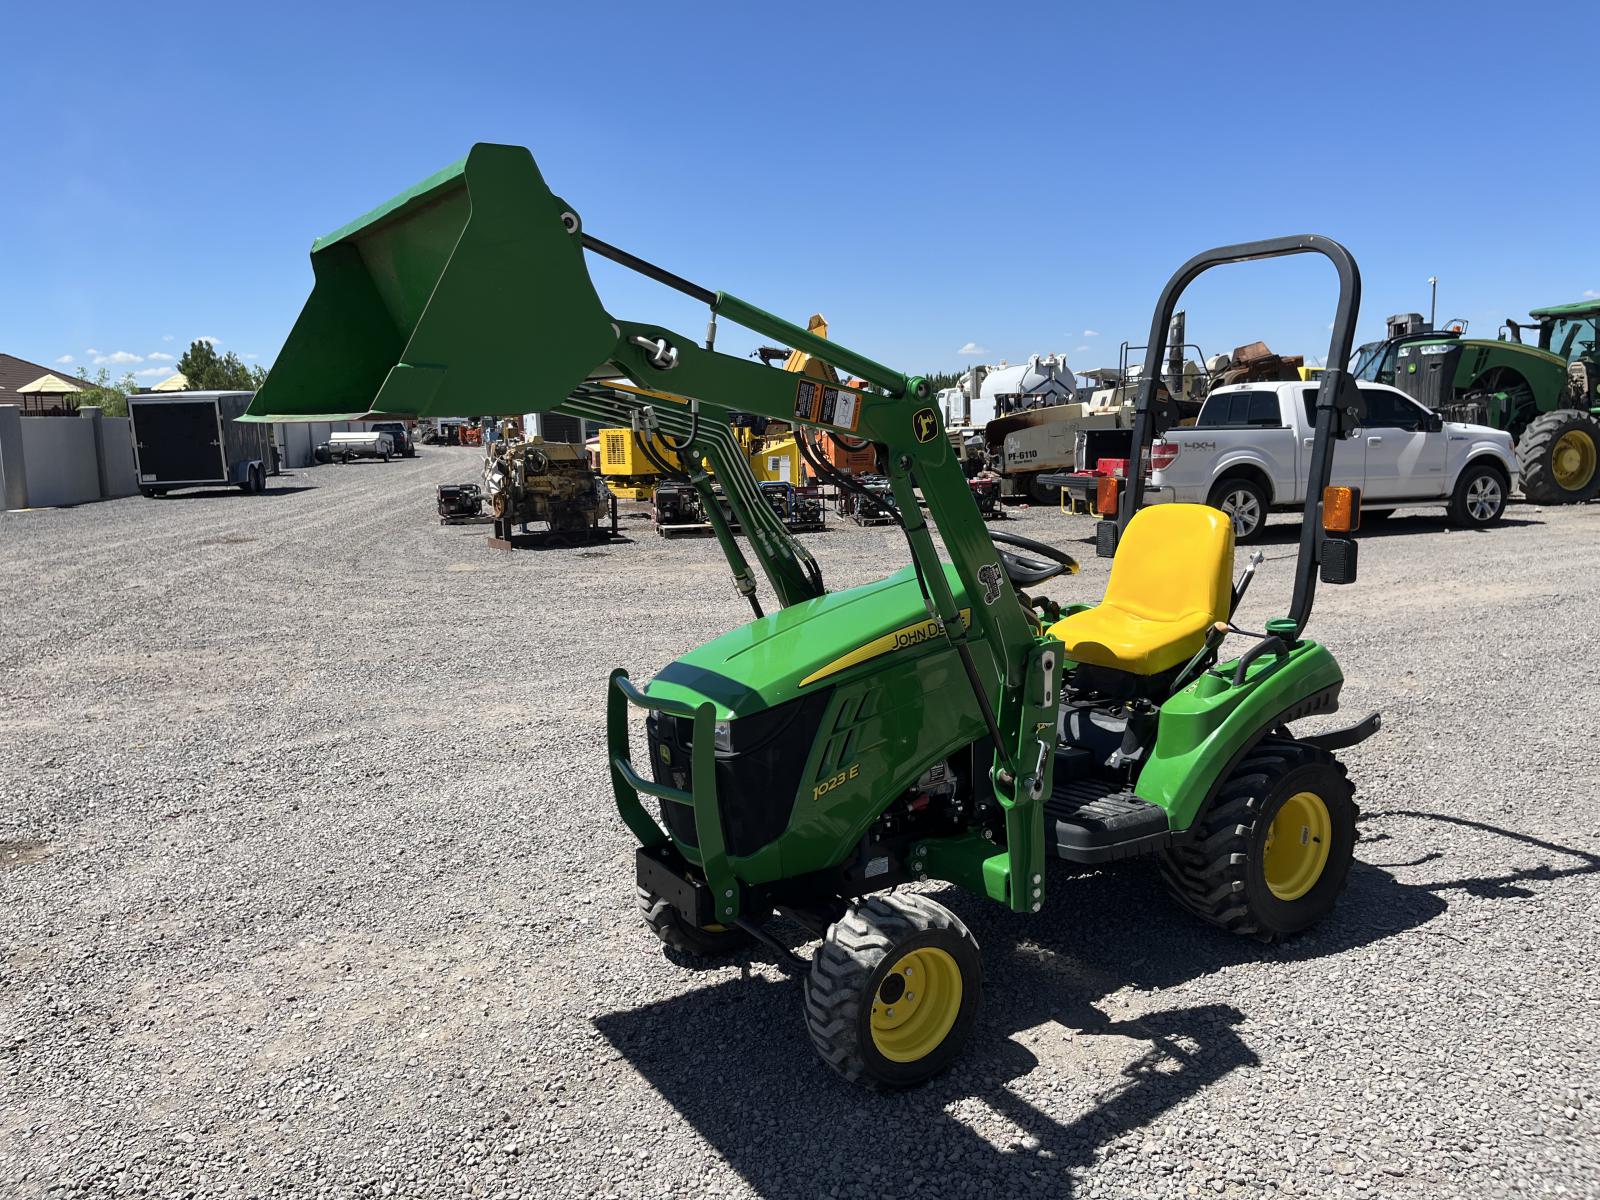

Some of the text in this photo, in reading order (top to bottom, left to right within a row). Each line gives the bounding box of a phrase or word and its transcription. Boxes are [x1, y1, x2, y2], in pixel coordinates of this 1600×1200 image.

[892, 628, 926, 650] JOHN
[812, 763, 860, 801] 1023 E
